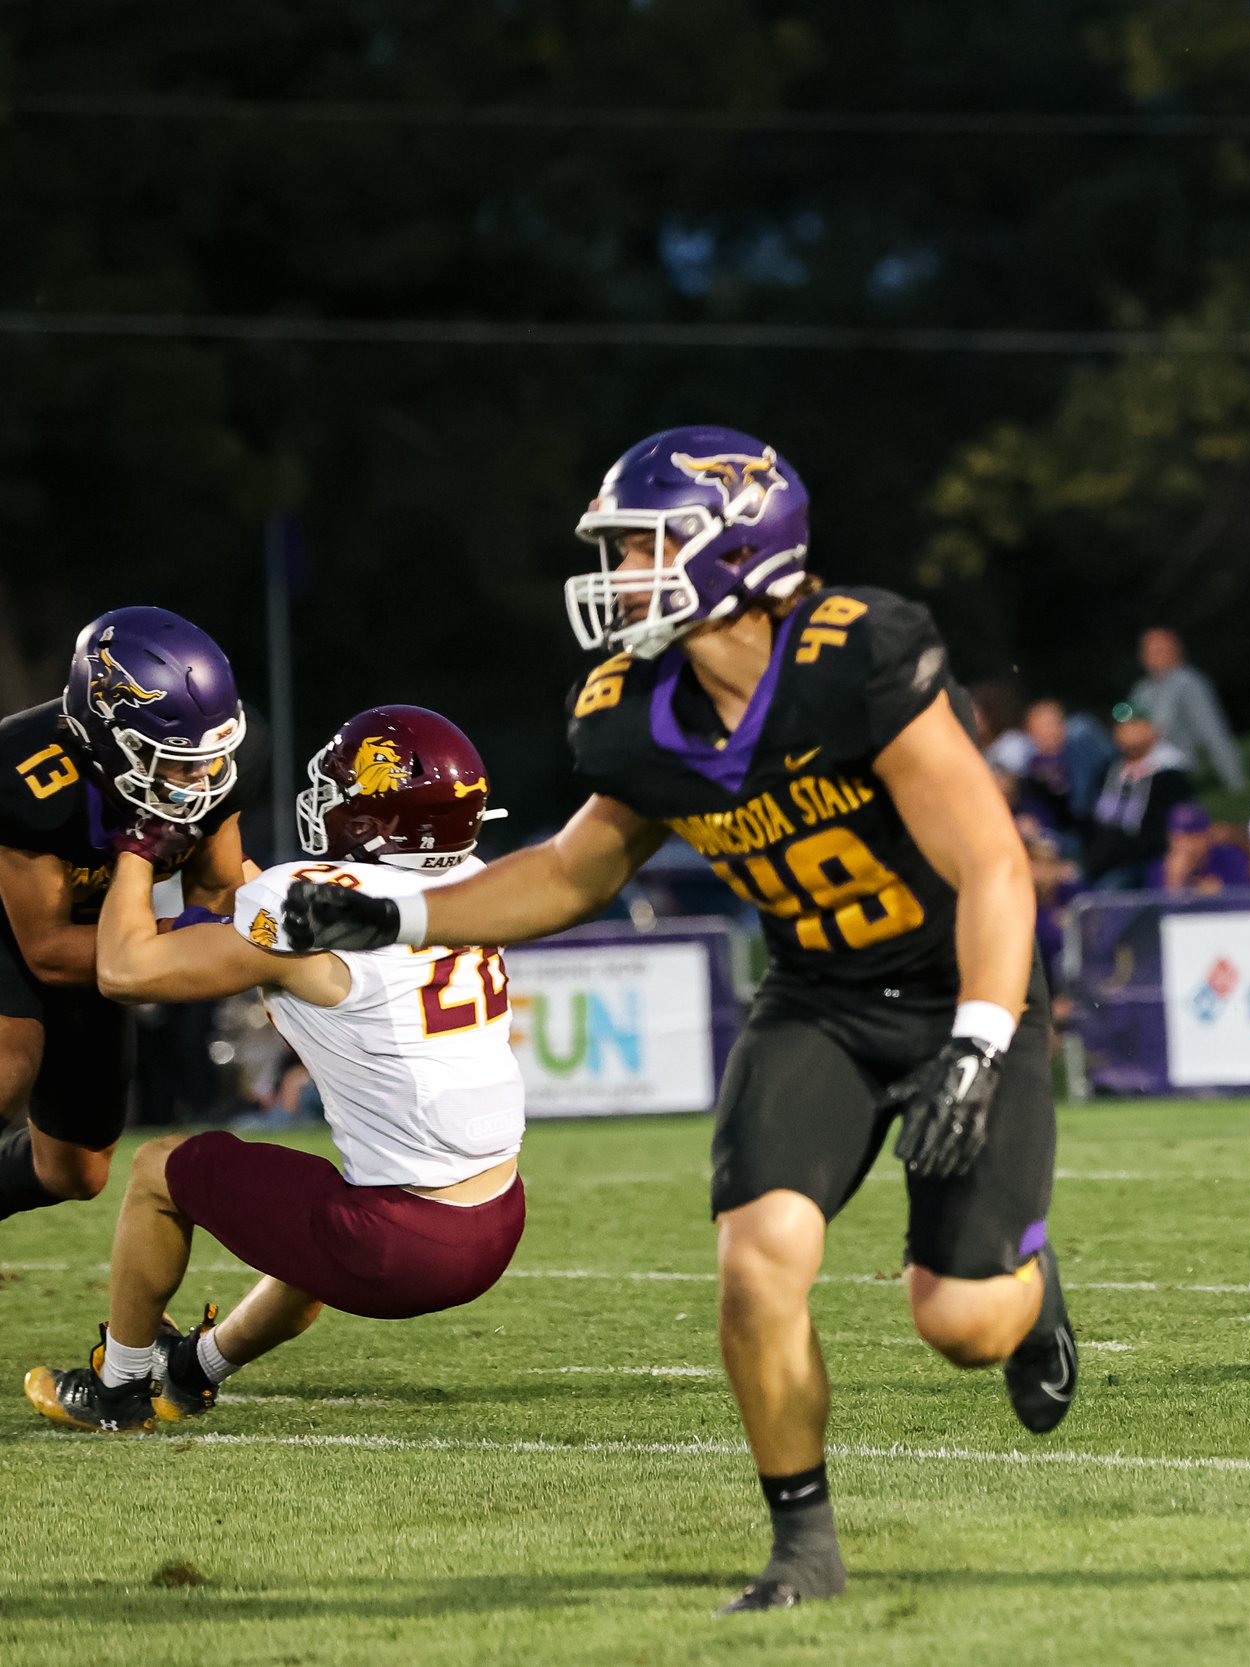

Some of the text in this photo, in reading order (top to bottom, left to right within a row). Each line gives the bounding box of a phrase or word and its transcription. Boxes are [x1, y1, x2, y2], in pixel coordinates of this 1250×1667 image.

[796, 594, 868, 664] 48
[15, 743, 79, 799] 13
[664, 791, 796, 855] INNESOTA
[711, 826, 925, 950] 48
